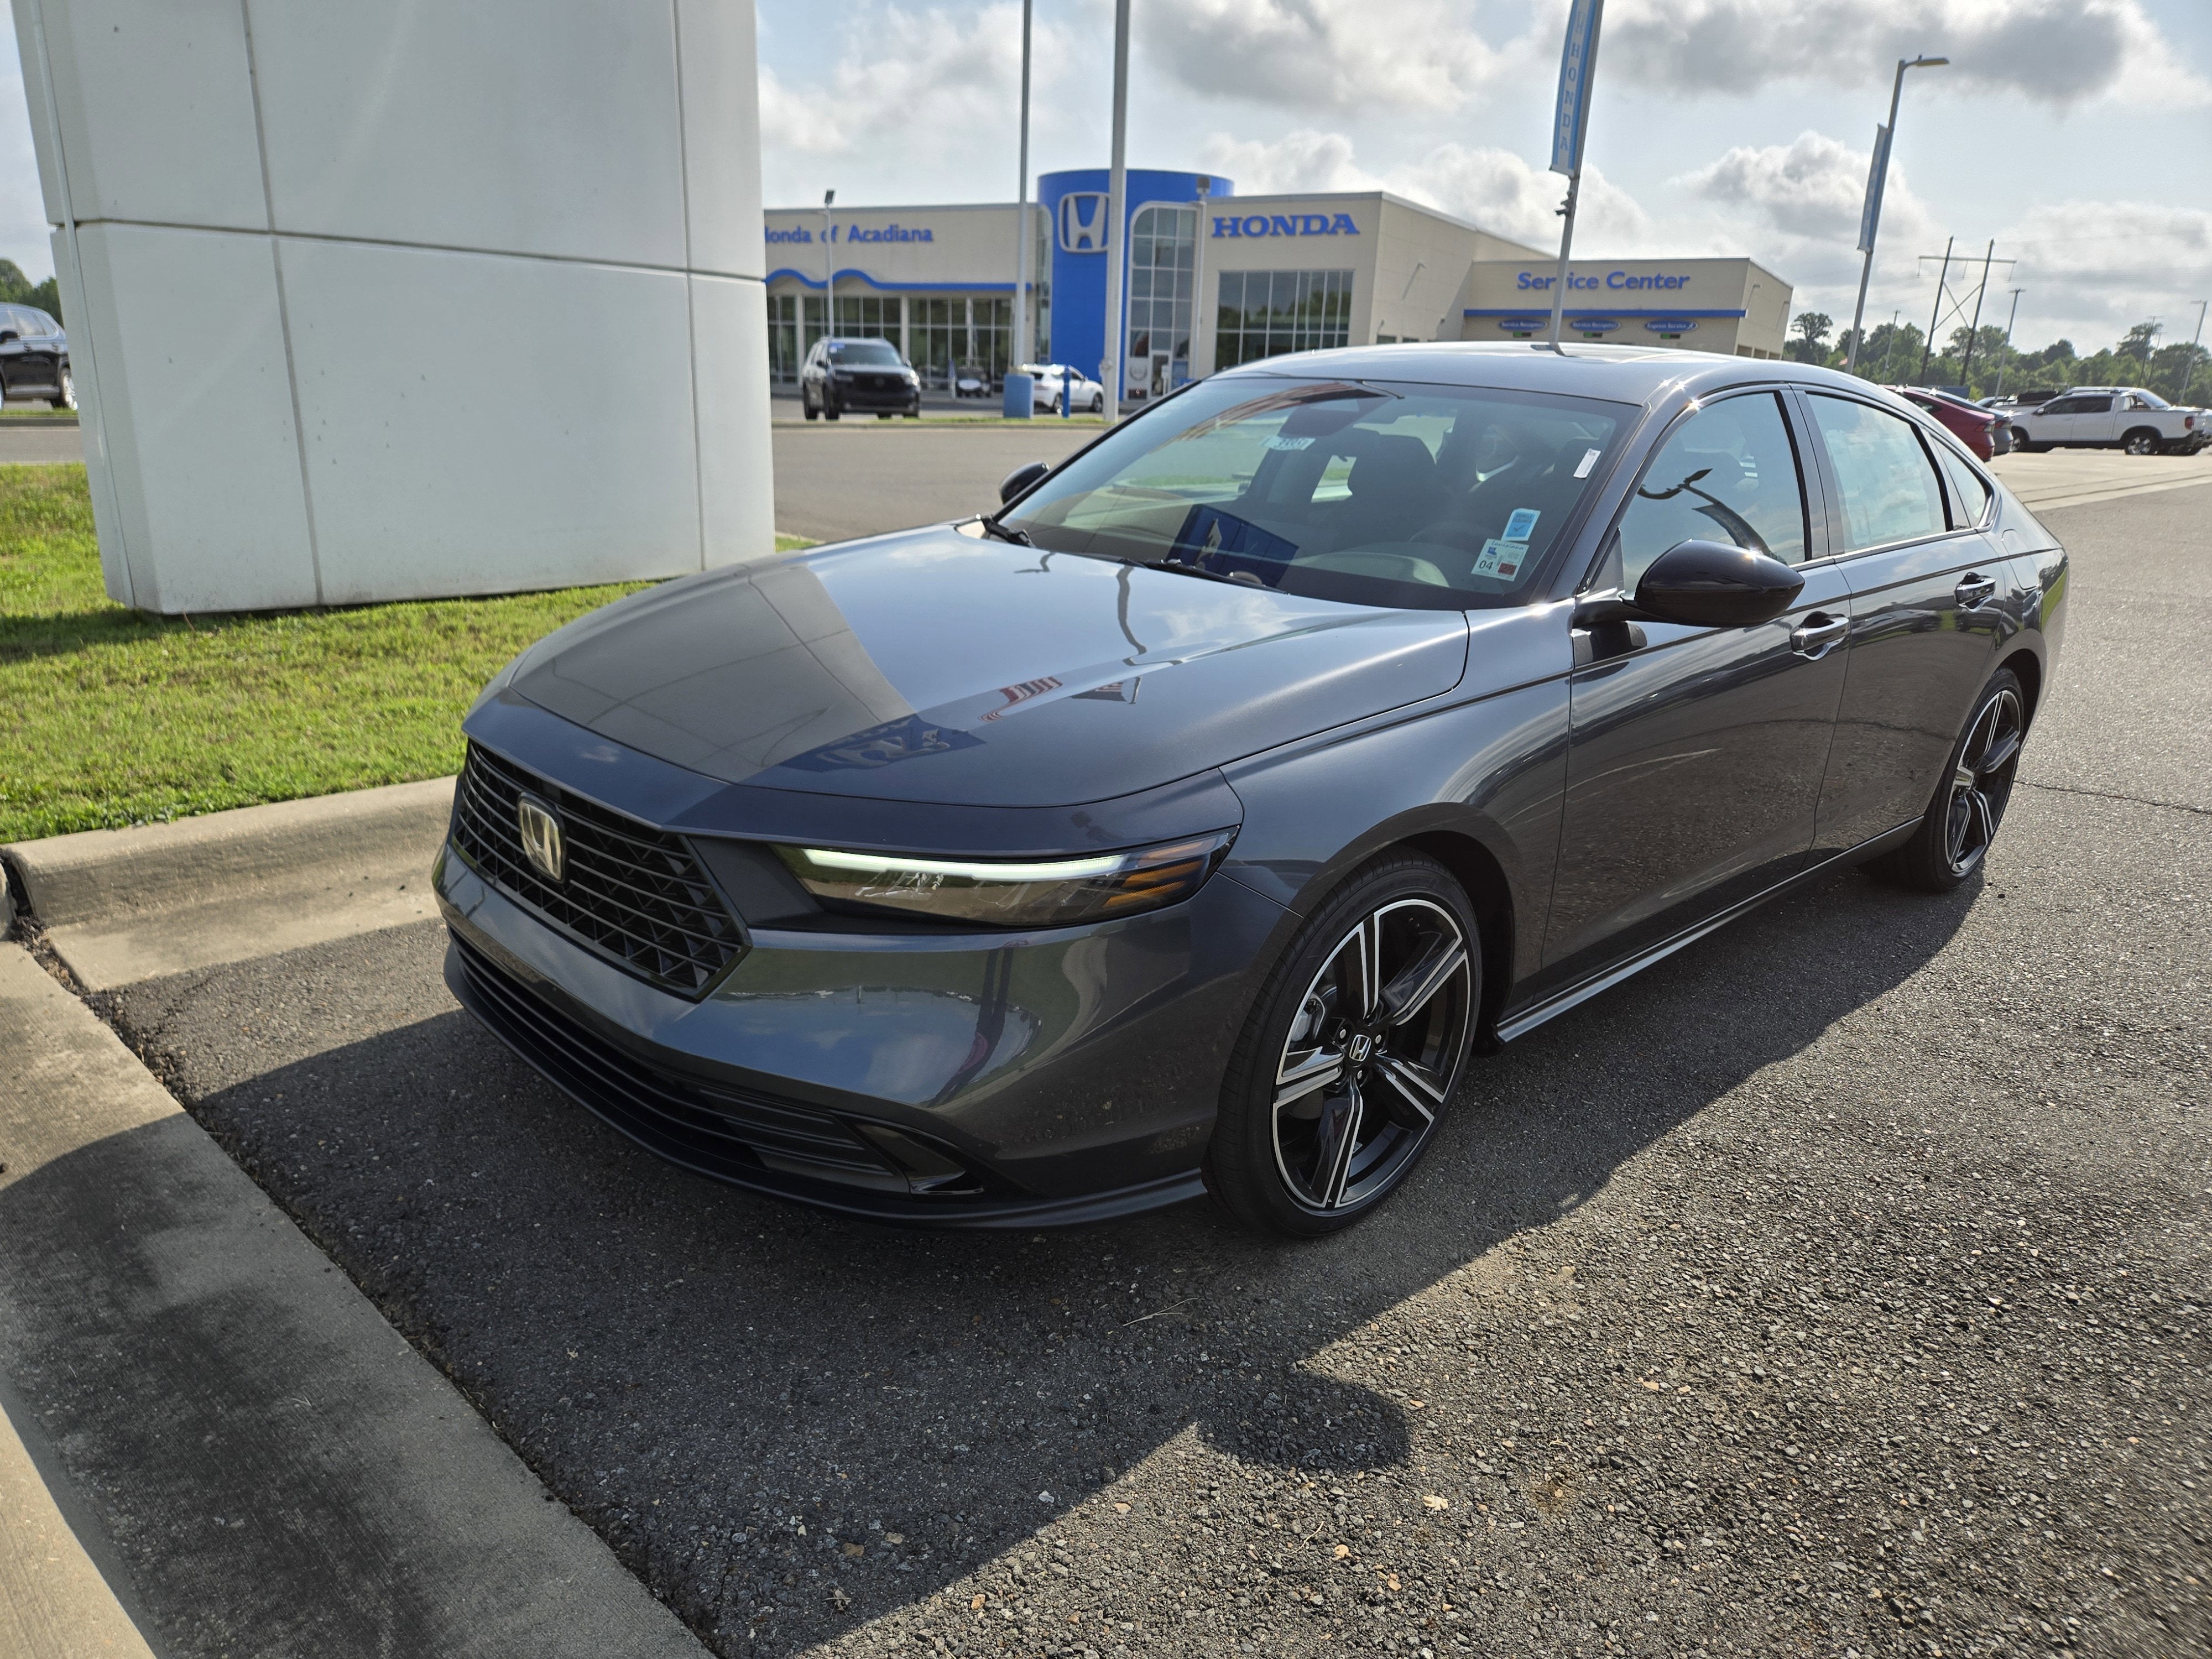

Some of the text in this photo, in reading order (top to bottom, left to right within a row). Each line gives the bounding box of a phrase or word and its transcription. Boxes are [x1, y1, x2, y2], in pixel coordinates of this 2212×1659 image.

[1559, 43, 1580, 151] HONDA
[821, 224, 838, 243] of
[848, 224, 932, 242] Acadiana
[1212, 213, 1360, 238] HONDA
[1517, 271, 1691, 290] Serice Center
[1479, 560, 1494, 570] 04
